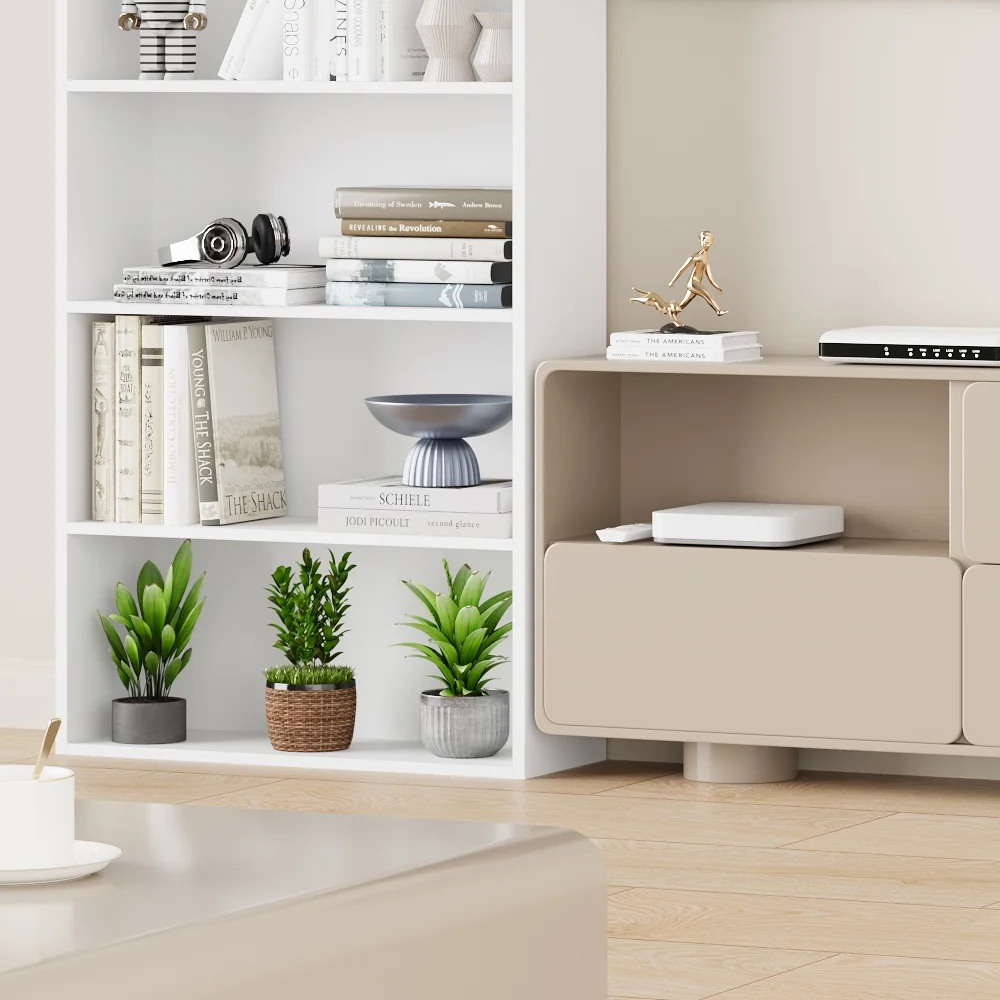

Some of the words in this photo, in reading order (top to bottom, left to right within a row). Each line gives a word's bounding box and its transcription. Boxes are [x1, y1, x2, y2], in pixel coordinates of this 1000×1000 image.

[354, 201, 387, 210] Dreaming
[349, 224, 386, 232] REVEALING
[399, 224, 442, 232] Revolution
[243, 327, 249, 340] P.
[248, 325, 273, 339] YOUNG
[191, 349, 206, 397] YOUNG
[194, 410, 208, 438] THE
[196, 441, 213, 485] SHACK
[225, 494, 248, 516] THE
[250, 490, 287, 512] SHACK
[379, 493, 431, 507] SCHIELE
[345, 516, 367, 527] JODI
[369, 517, 410, 528] PICOULT
[455, 520, 480, 529] glance
